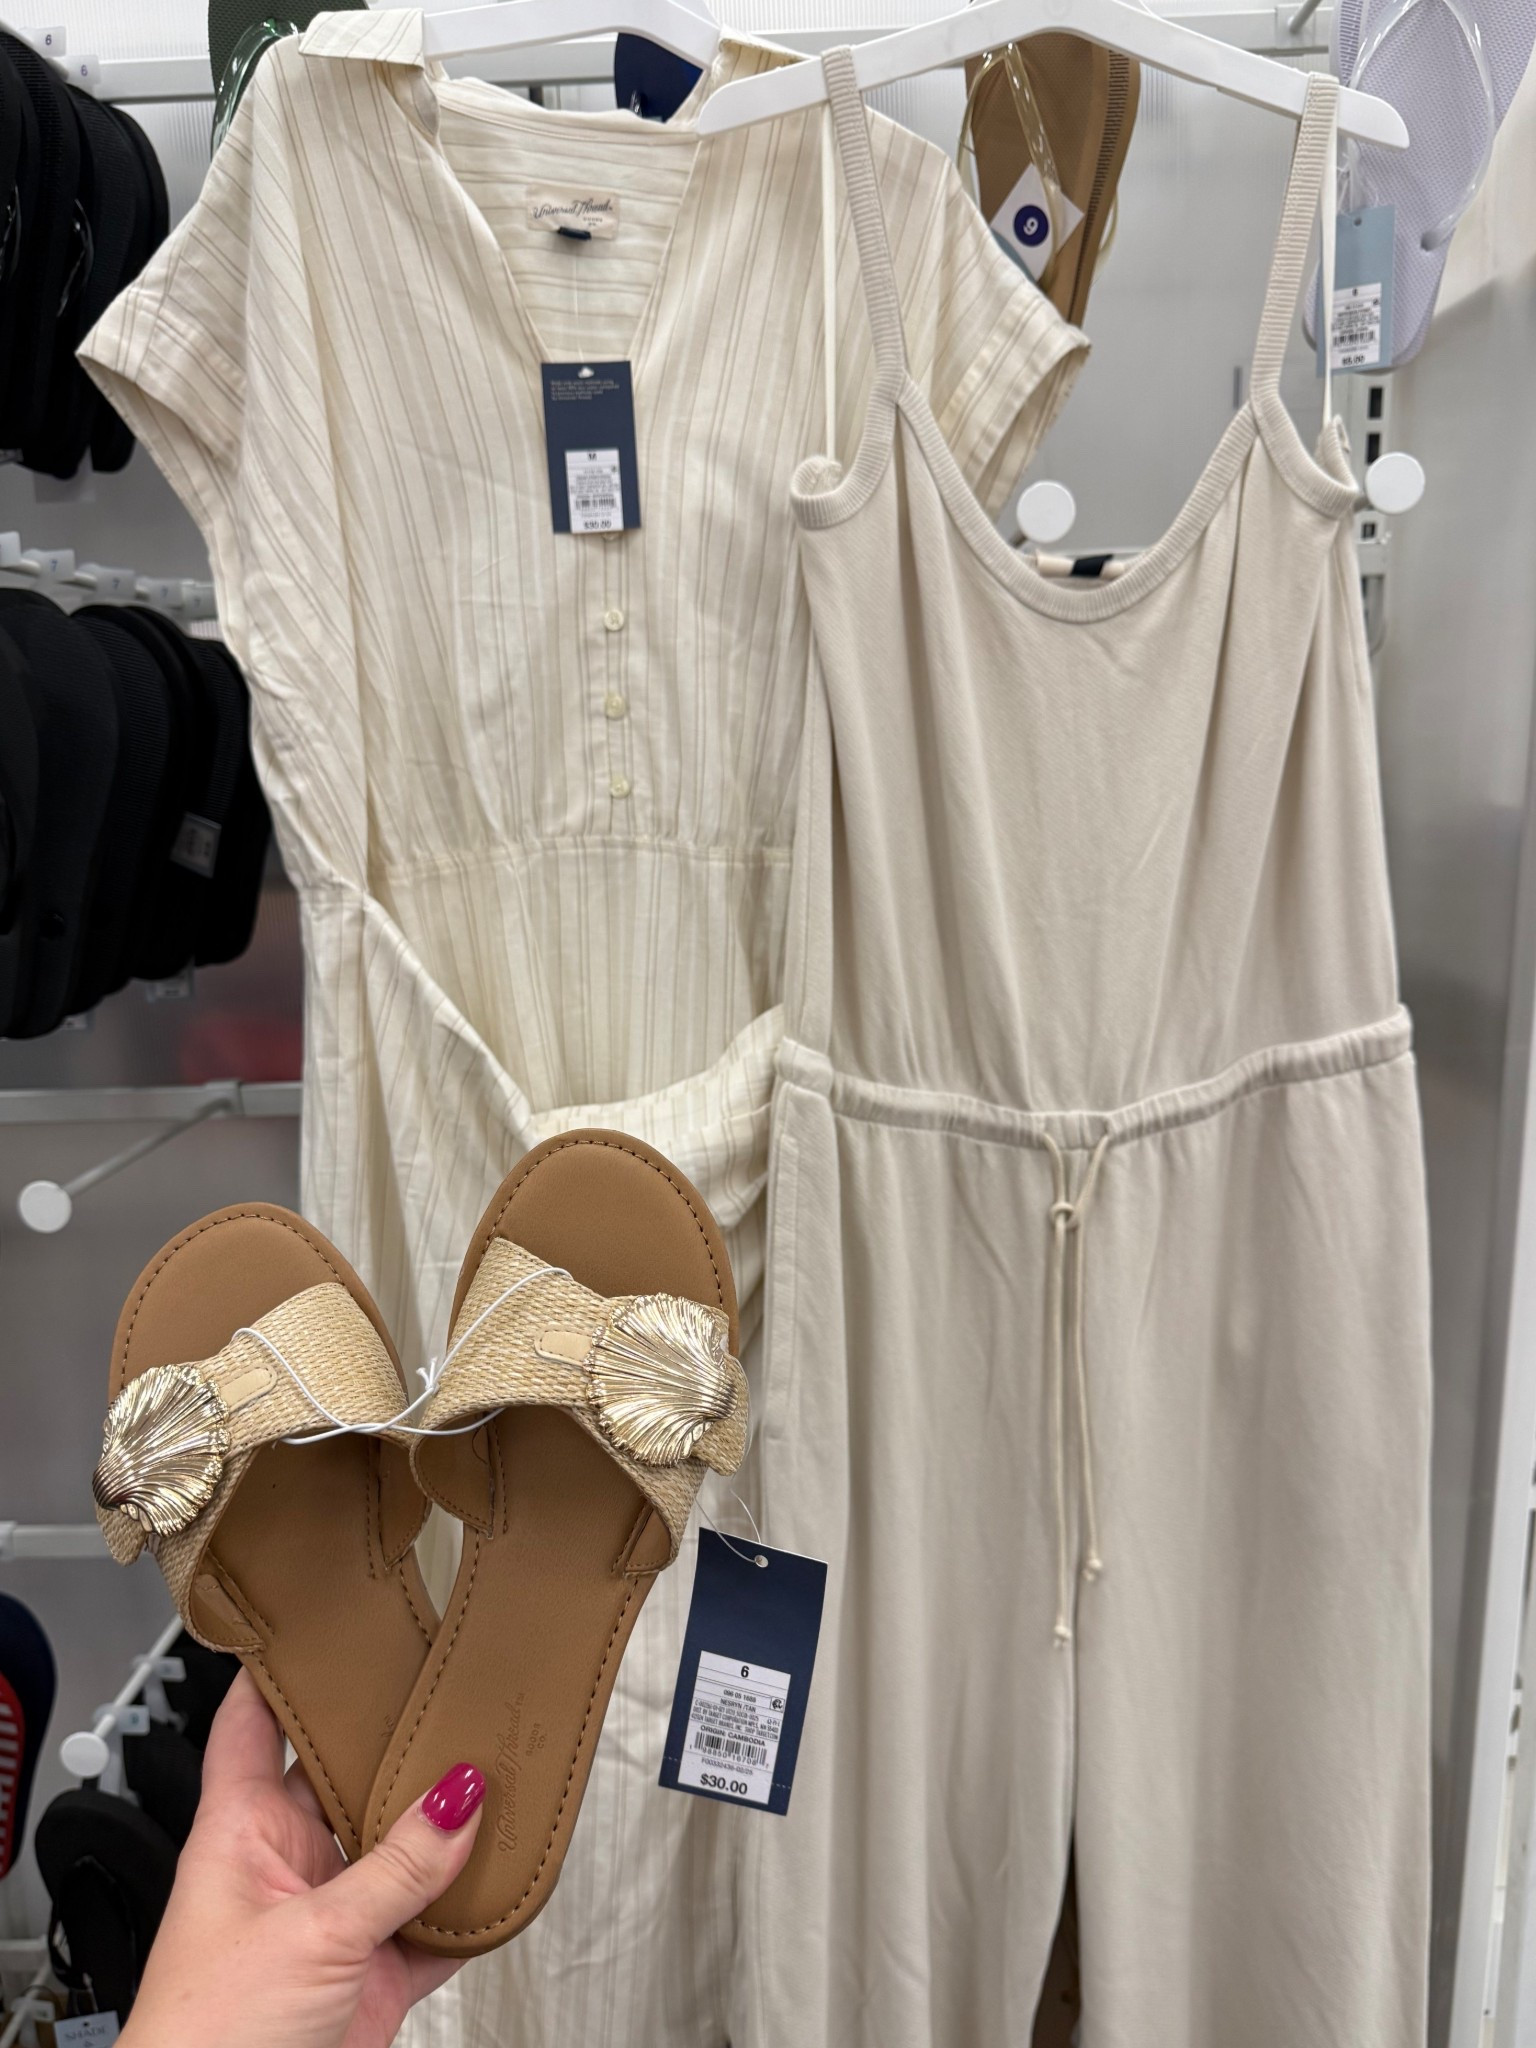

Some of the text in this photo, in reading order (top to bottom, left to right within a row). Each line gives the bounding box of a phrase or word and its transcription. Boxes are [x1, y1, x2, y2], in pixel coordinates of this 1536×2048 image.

[45, 34, 52, 46] 6
[80, 64, 88, 77] 6
[51, 560, 58, 572] 7
[741, 1666, 749, 1678] 6
[496, 1702, 524, 1775] Thread
[727, 1732, 765, 1746] CAMBODIA
[700, 1773, 748, 1795] $30.00
[497, 1766, 518, 1852] Universal
